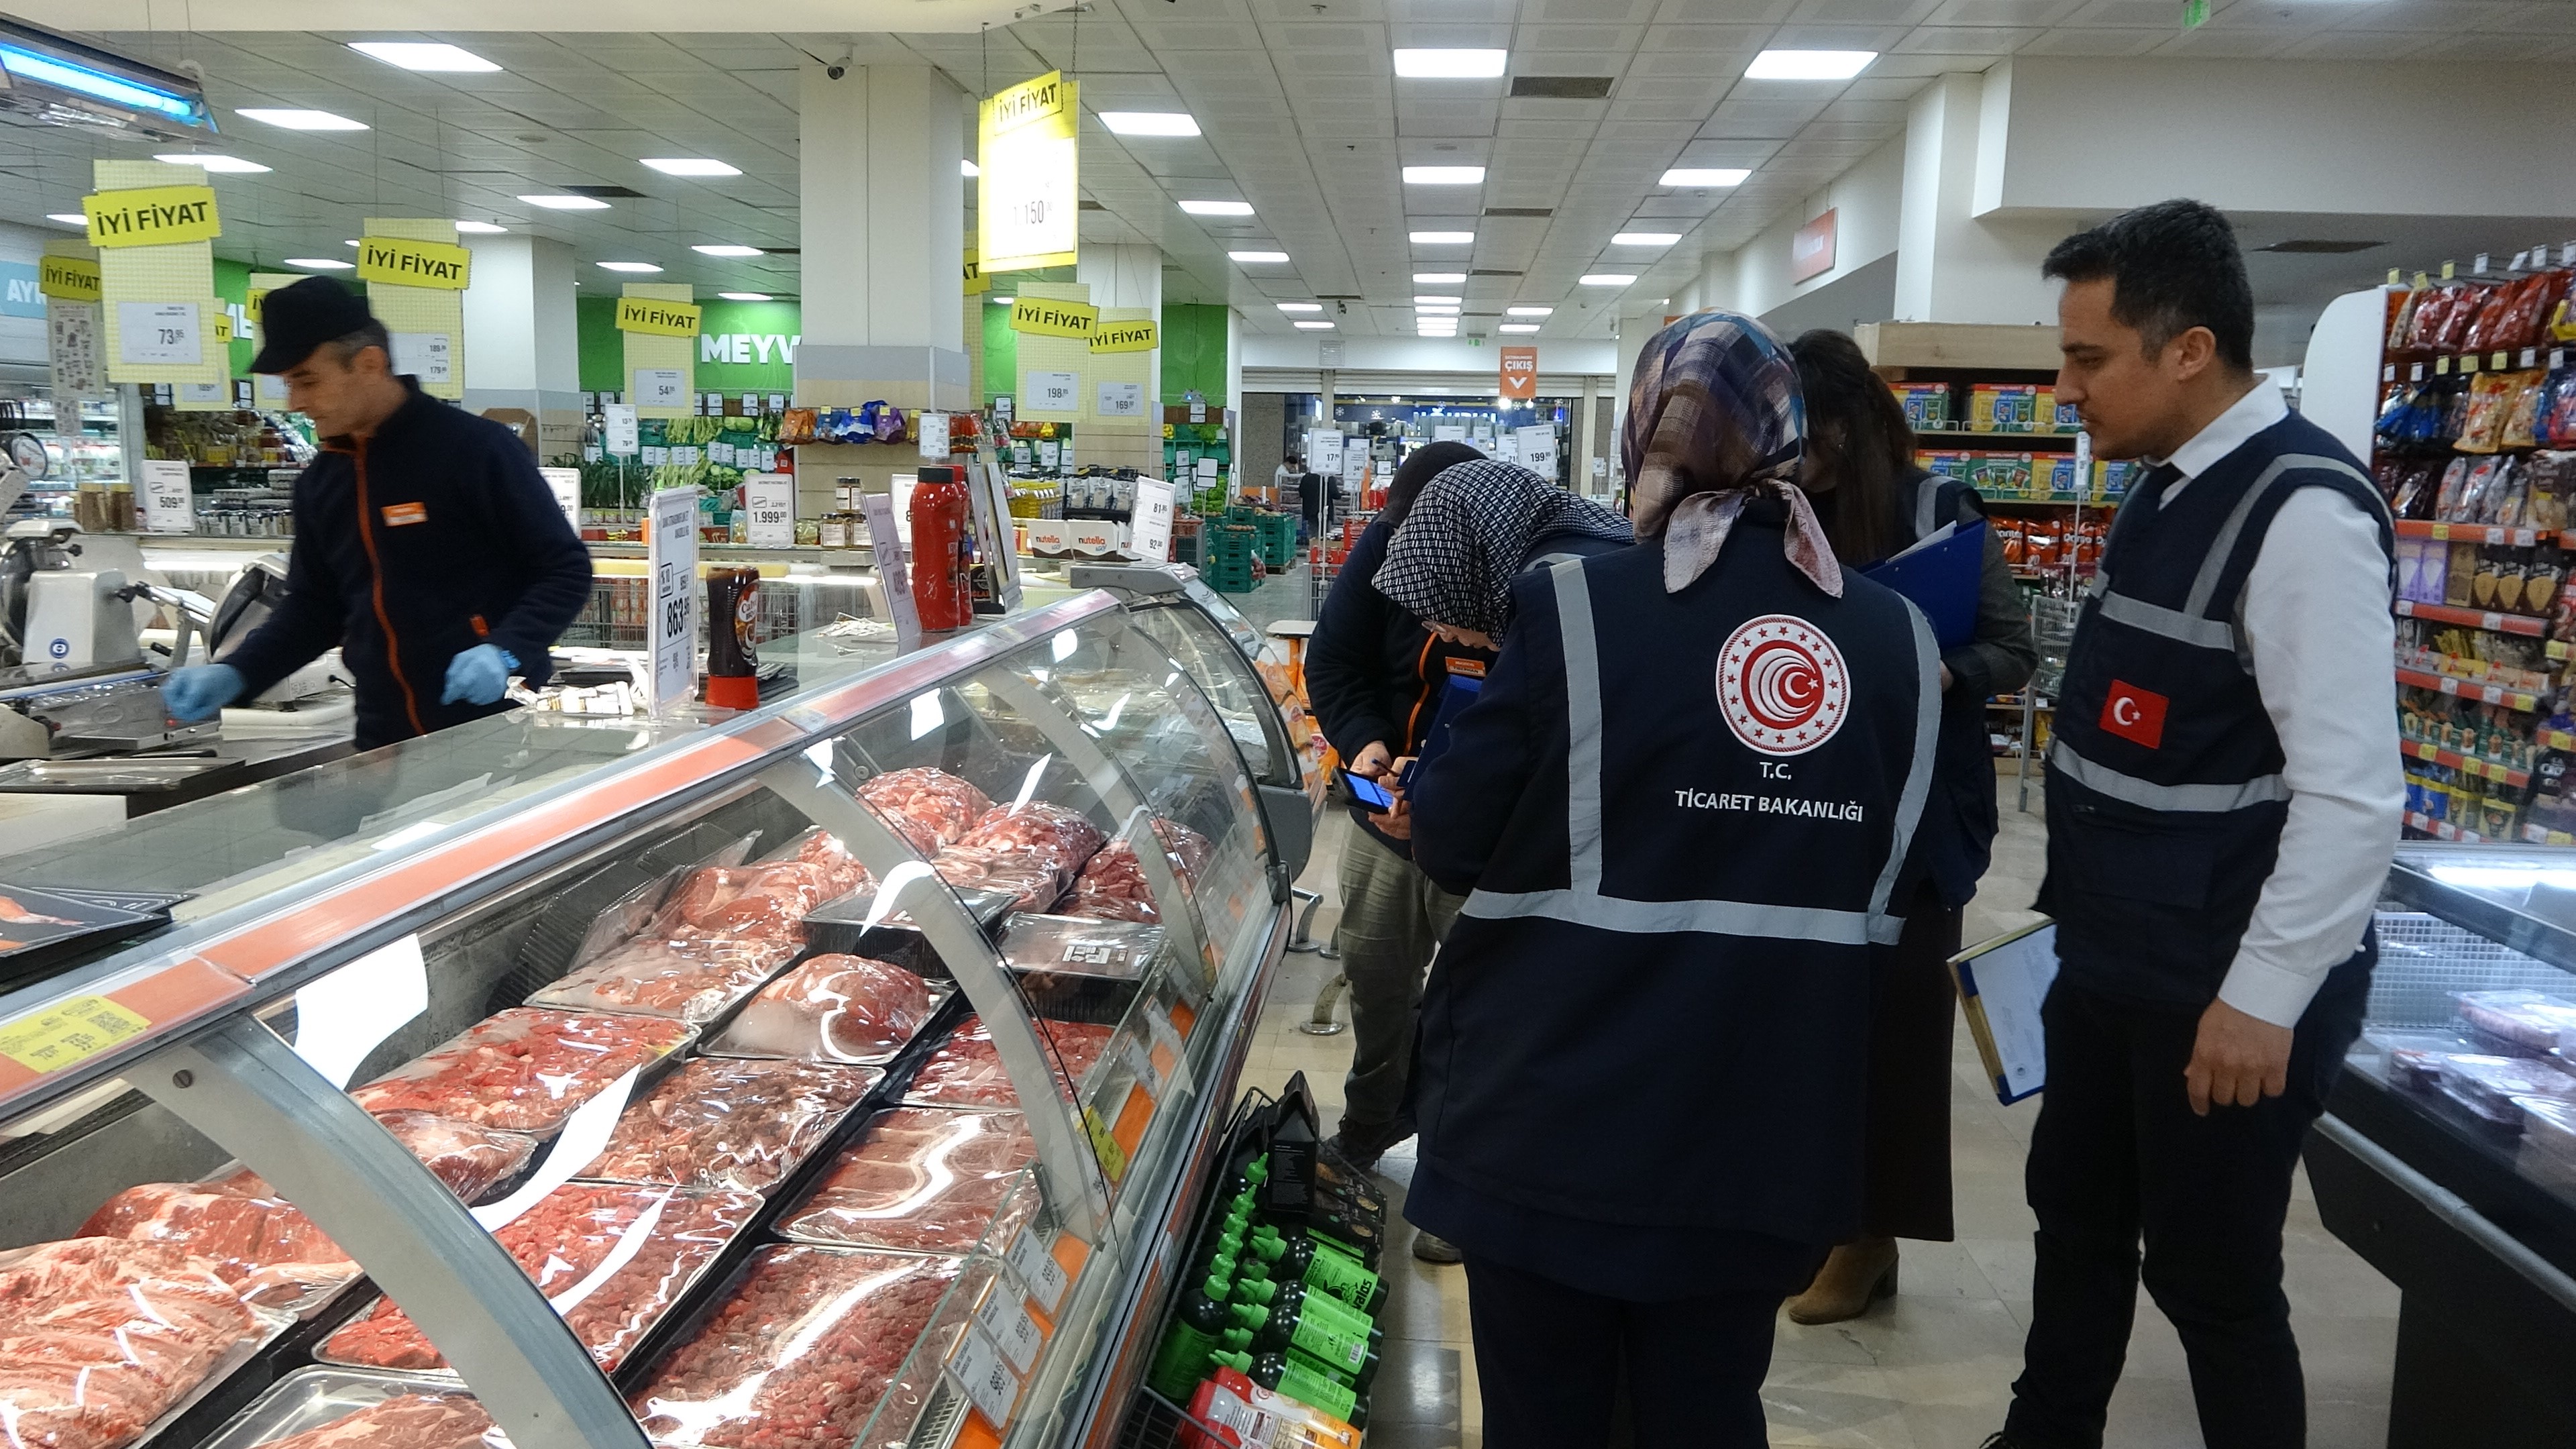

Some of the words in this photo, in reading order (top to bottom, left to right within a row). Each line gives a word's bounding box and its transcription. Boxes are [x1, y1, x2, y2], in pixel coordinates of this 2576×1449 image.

[1000, 94, 1016, 122] İYİ
[1020, 83, 1057, 115] FİYAT
[97, 207, 131, 236] İYİ
[137, 201, 208, 231] FİYAT
[366, 245, 396, 269] İYİ
[400, 253, 462, 280] FİYAT
[46, 265, 62, 285] İYİ
[66, 269, 99, 292] FİYAT
[625, 305, 647, 323] İYİ
[650, 309, 696, 329] FİYAT
[1018, 304, 1040, 323] İYİ
[1044, 309, 1091, 331] FİYAT
[1112, 328, 1152, 344] FİYAT
[1505, 360, 1534, 372] ÇIKIŞ
[1036, 535, 1060, 544] nutella
[1079, 535, 1106, 545] nutella
[667, 597, 684, 638] 863
[1760, 761, 1792, 780] T.C.
[1675, 788, 1754, 811] TİCARET
[1758, 796, 1863, 822] BAKANLIĞI
